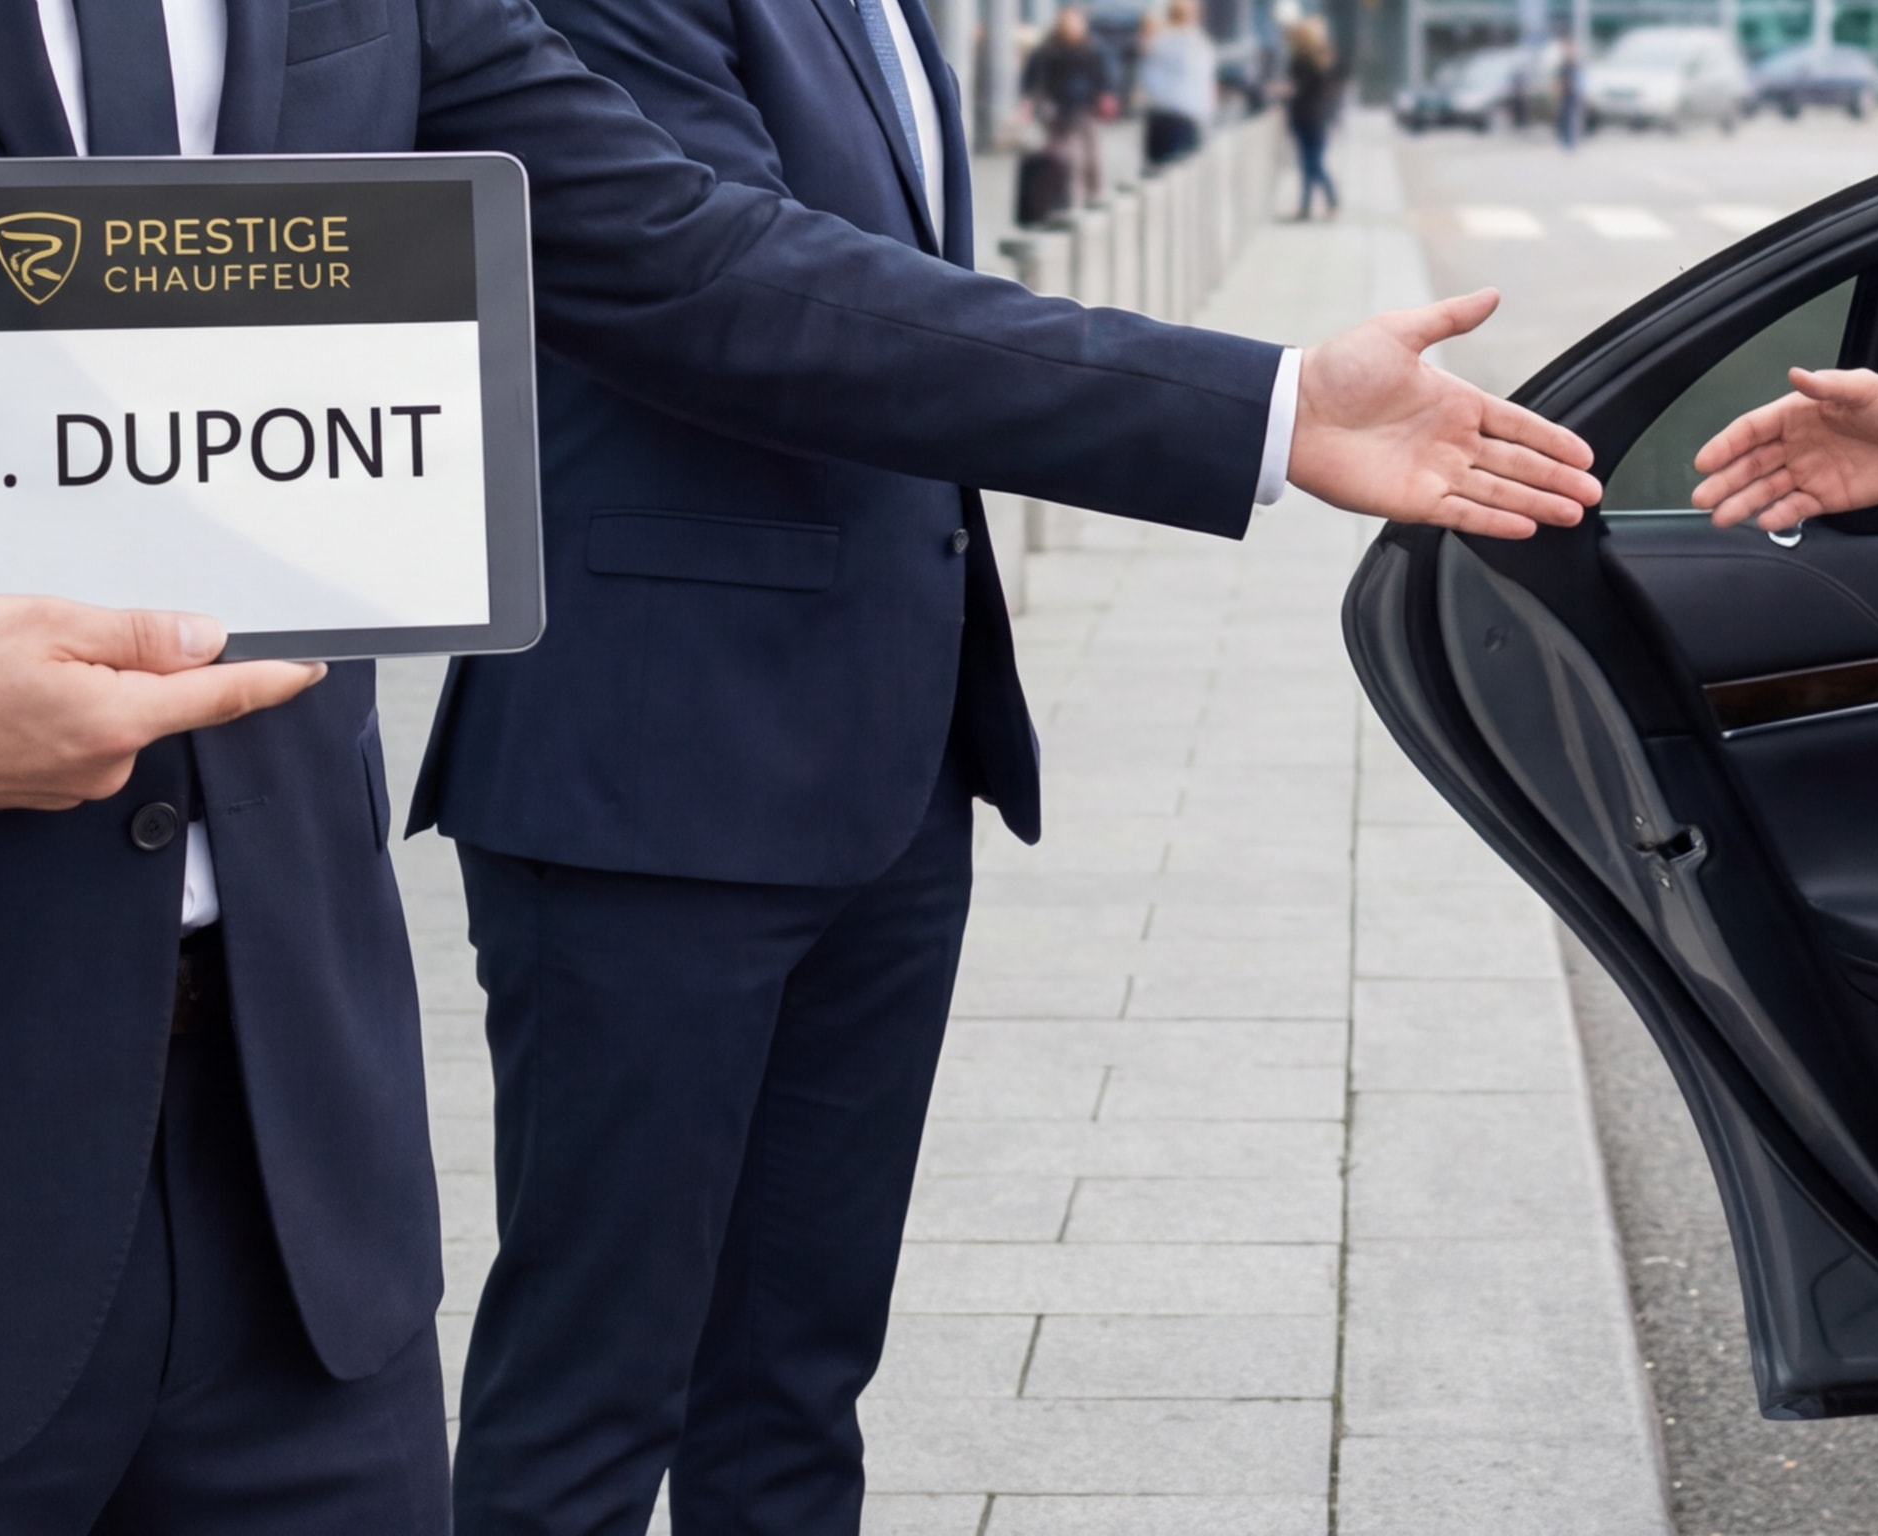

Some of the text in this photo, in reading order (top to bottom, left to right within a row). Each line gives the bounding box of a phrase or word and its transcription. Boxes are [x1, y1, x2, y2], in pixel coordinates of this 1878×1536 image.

[104, 216, 349, 256] PRESTIGE
[104, 262, 351, 293] CHAUFFEUR
[56, 405, 442, 487] DUPONT
